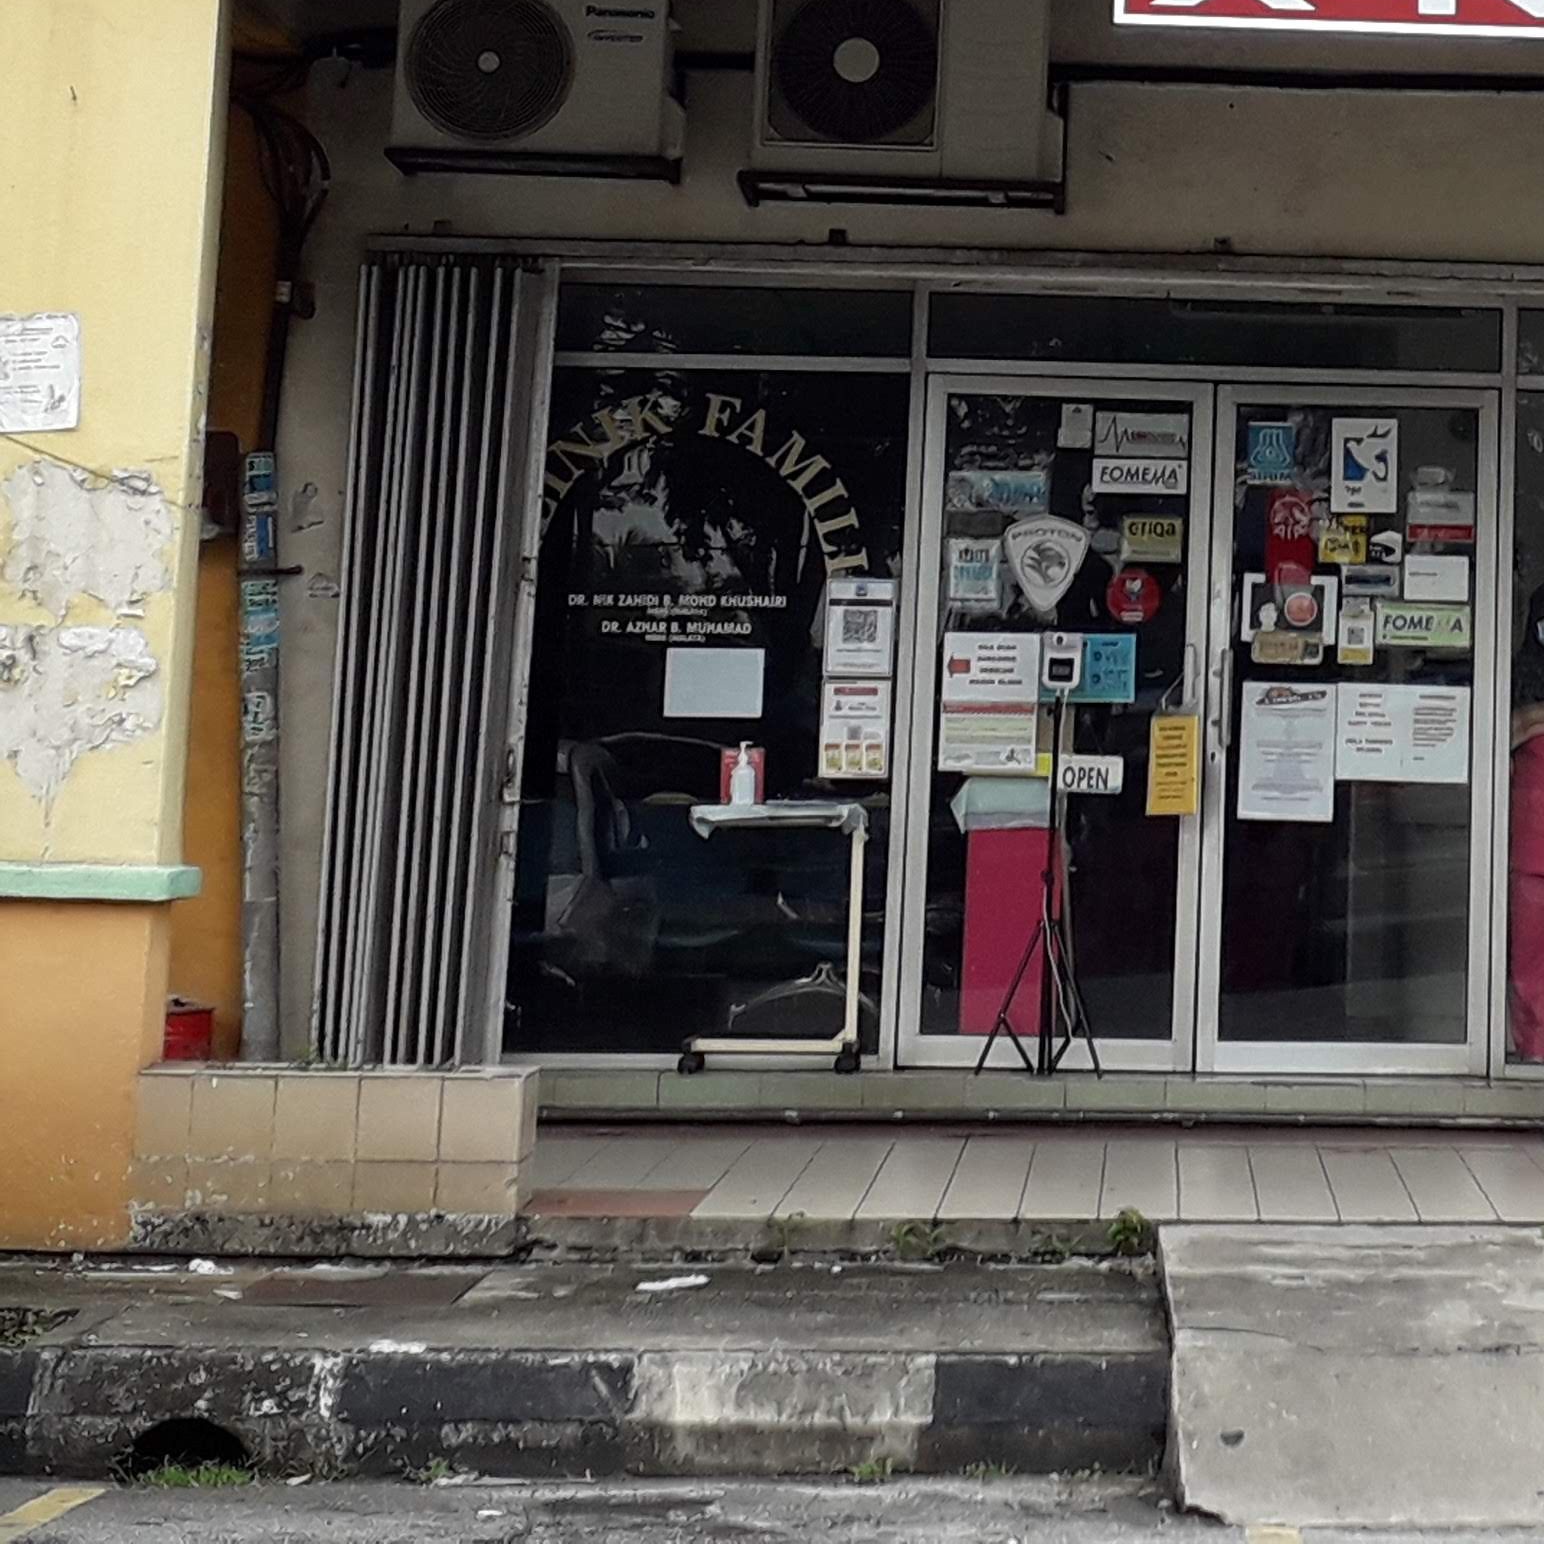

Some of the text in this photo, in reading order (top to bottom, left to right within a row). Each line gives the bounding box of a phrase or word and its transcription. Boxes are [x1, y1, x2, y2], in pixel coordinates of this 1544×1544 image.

[698, 393, 870, 576] FAMILI
[1011, 527, 1083, 542] PROTON
[1383, 614, 1464, 633] FOMEA
[1062, 765, 1109, 791] OPEN
